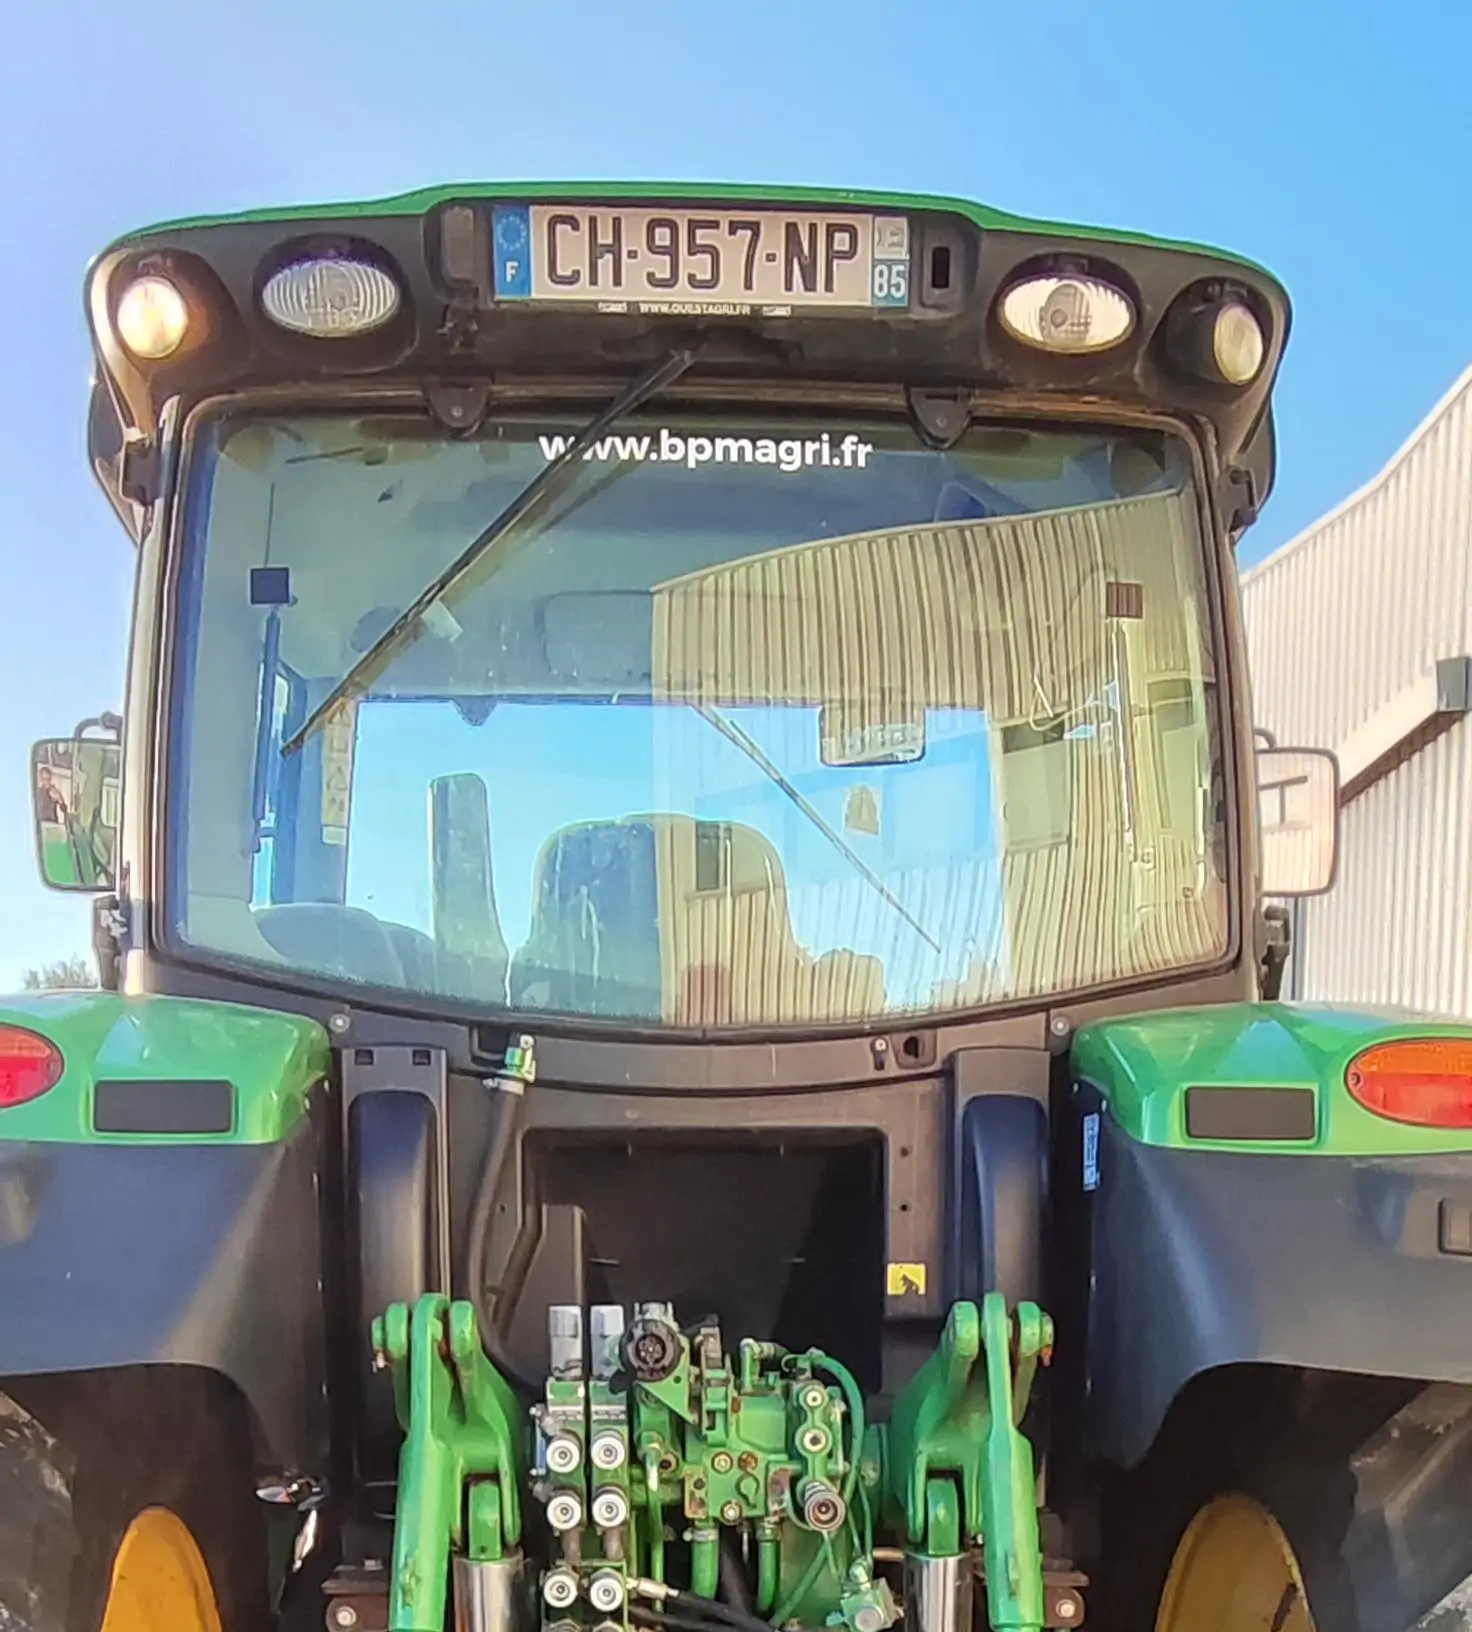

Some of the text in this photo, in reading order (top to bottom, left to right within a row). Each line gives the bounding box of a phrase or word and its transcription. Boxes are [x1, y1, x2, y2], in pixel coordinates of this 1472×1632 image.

[506, 261, 519, 282] F
[547, 213, 859, 294] CH-957-NP
[874, 264, 906, 298] 85
[538, 428, 872, 471] www.bpmagri.fr
